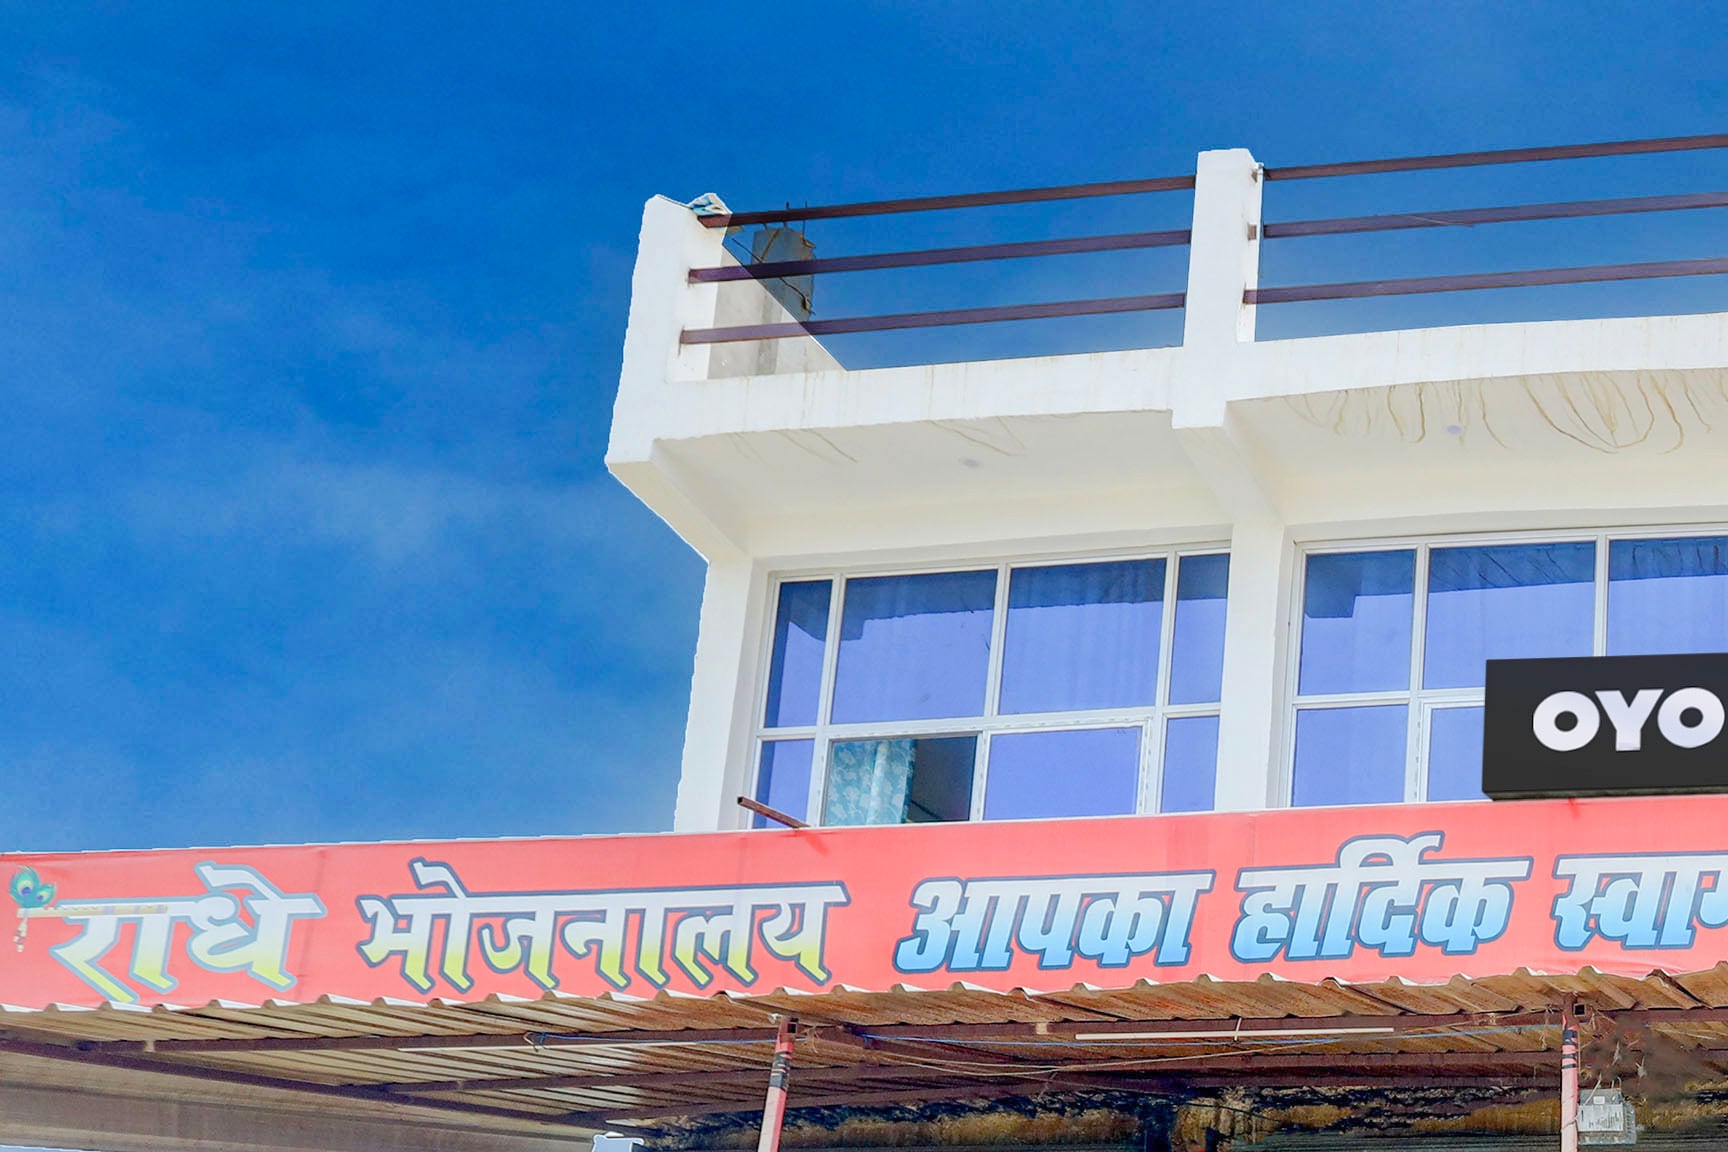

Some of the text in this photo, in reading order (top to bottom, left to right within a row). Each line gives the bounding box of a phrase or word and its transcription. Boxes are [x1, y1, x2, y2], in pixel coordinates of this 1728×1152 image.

[1533, 687, 1725, 752] OYO
[50, 861, 328, 1002] राधे
[357, 855, 851, 993] भोजनालय
[893, 868, 1216, 973] आपका
[1230, 831, 1533, 963] हार्दिक
